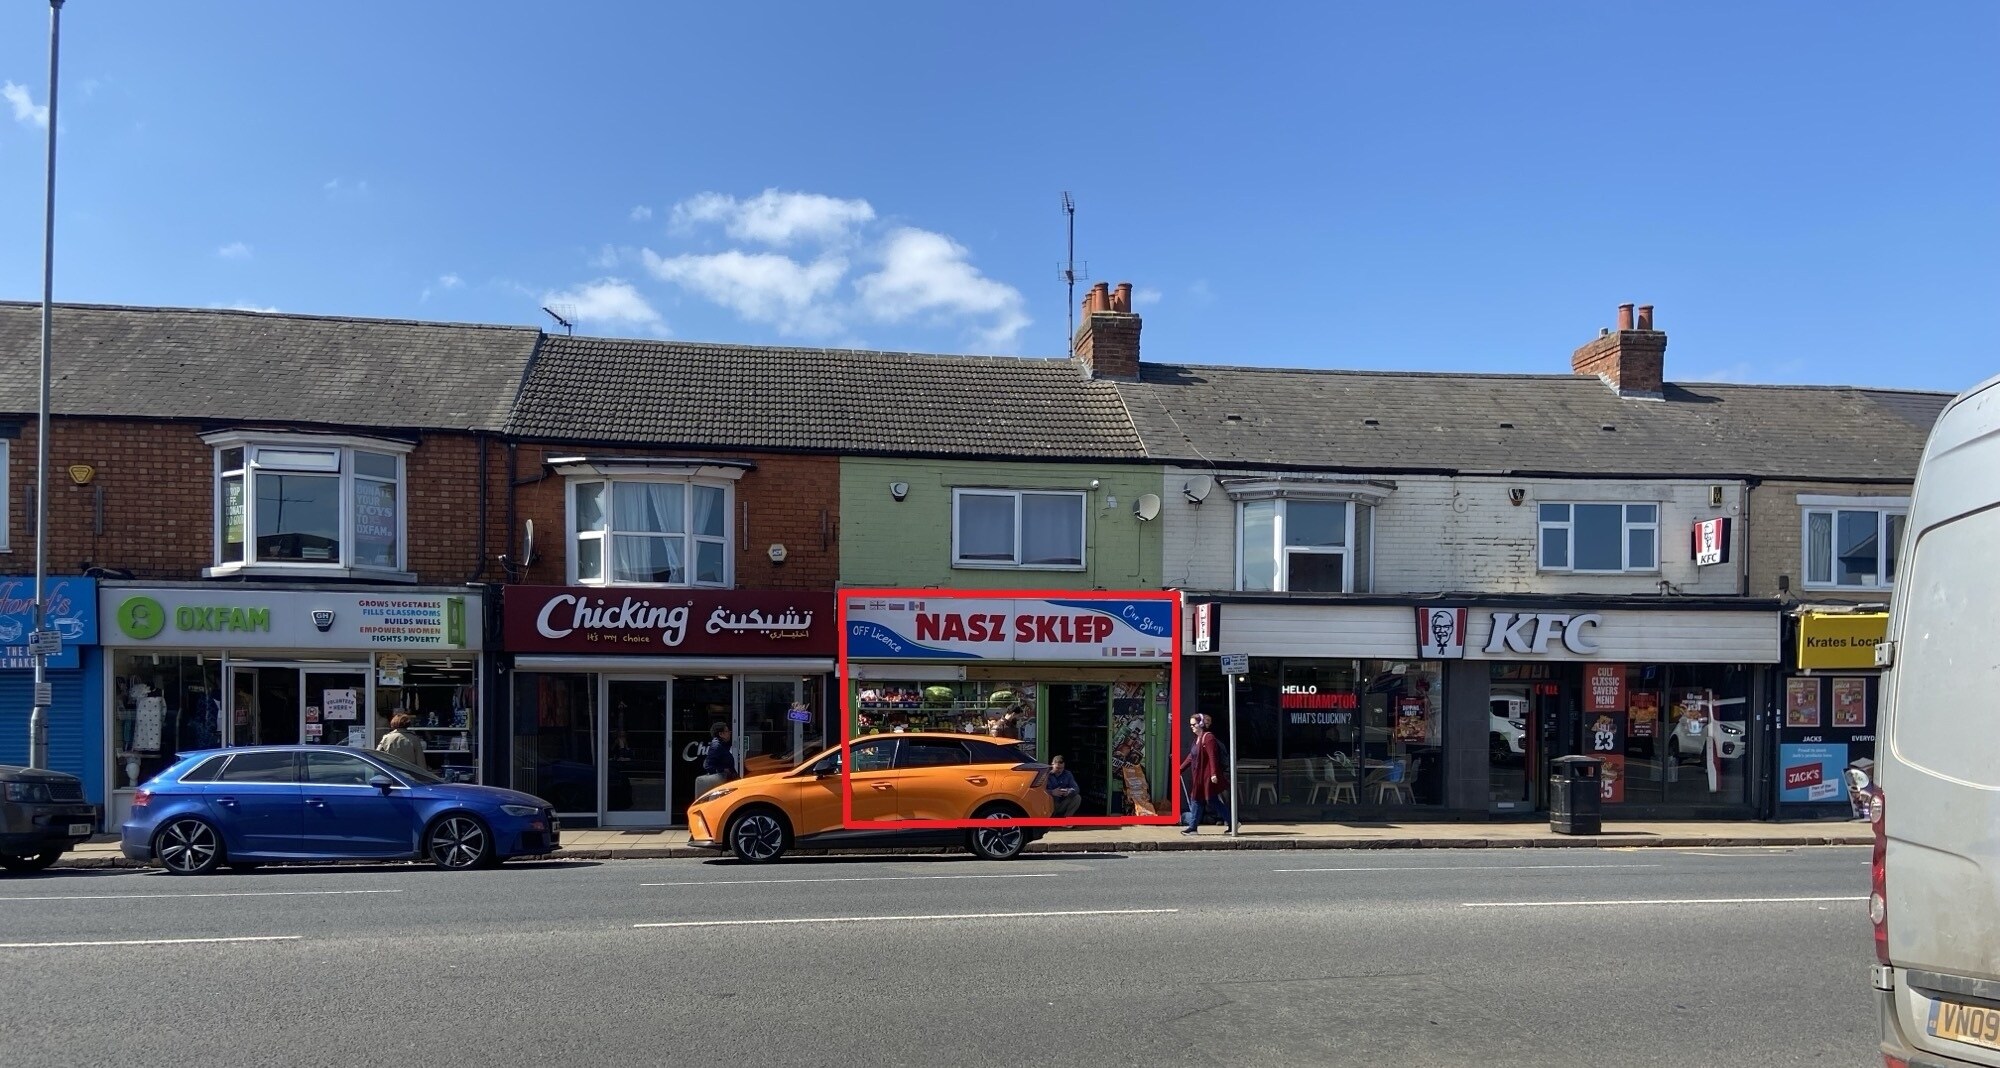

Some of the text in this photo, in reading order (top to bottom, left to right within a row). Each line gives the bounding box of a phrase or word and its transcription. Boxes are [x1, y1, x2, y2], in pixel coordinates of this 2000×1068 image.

[357, 495, 380, 506] YOUR
[356, 505, 393, 518] TOYS
[357, 515, 369, 525] TO
[1701, 553, 1717, 564] KFC
[359, 600, 441, 609] GROWS VEGETABLES
[386, 609, 441, 617] CLASSROOMS
[175, 606, 270, 632] OXFAM
[415, 618, 441, 626] WELLS
[537, 594, 689, 647] Chicking
[1122, 604, 1164, 635] Our Shop
[359, 626, 441, 635] EMPOWERS WOMEN
[915, 613, 1114, 643] NASZ SKLEP
[1482, 611, 1602, 655] KFC
[371, 635, 441, 643] FIGHTS POVERTY
[587, 632, 650, 642] it's my choice
[852, 625, 902, 653] OFF Licence
[1806, 636, 1883, 648] Krates Local
[1197, 640, 1208, 650] KFC
[6, 646, 23, 656] THE
[11, 657, 48, 668] MAKES
[1597, 667, 1614, 676] CULT
[1591, 677, 1620, 686] CLASSIC
[1281, 685, 1317, 694] HELLO
[1593, 686, 1618, 695] SAVERS
[326, 698, 355, 706] VOLUNTEER
[1281, 694, 1358, 709] NORTHAMPTON
[1595, 696, 1615, 704] MENU
[1290, 712, 1352, 724] WHAT'S CLUCKIN'?
[1594, 731, 1614, 751] £3
[1788, 769, 1820, 784] JACK'S
